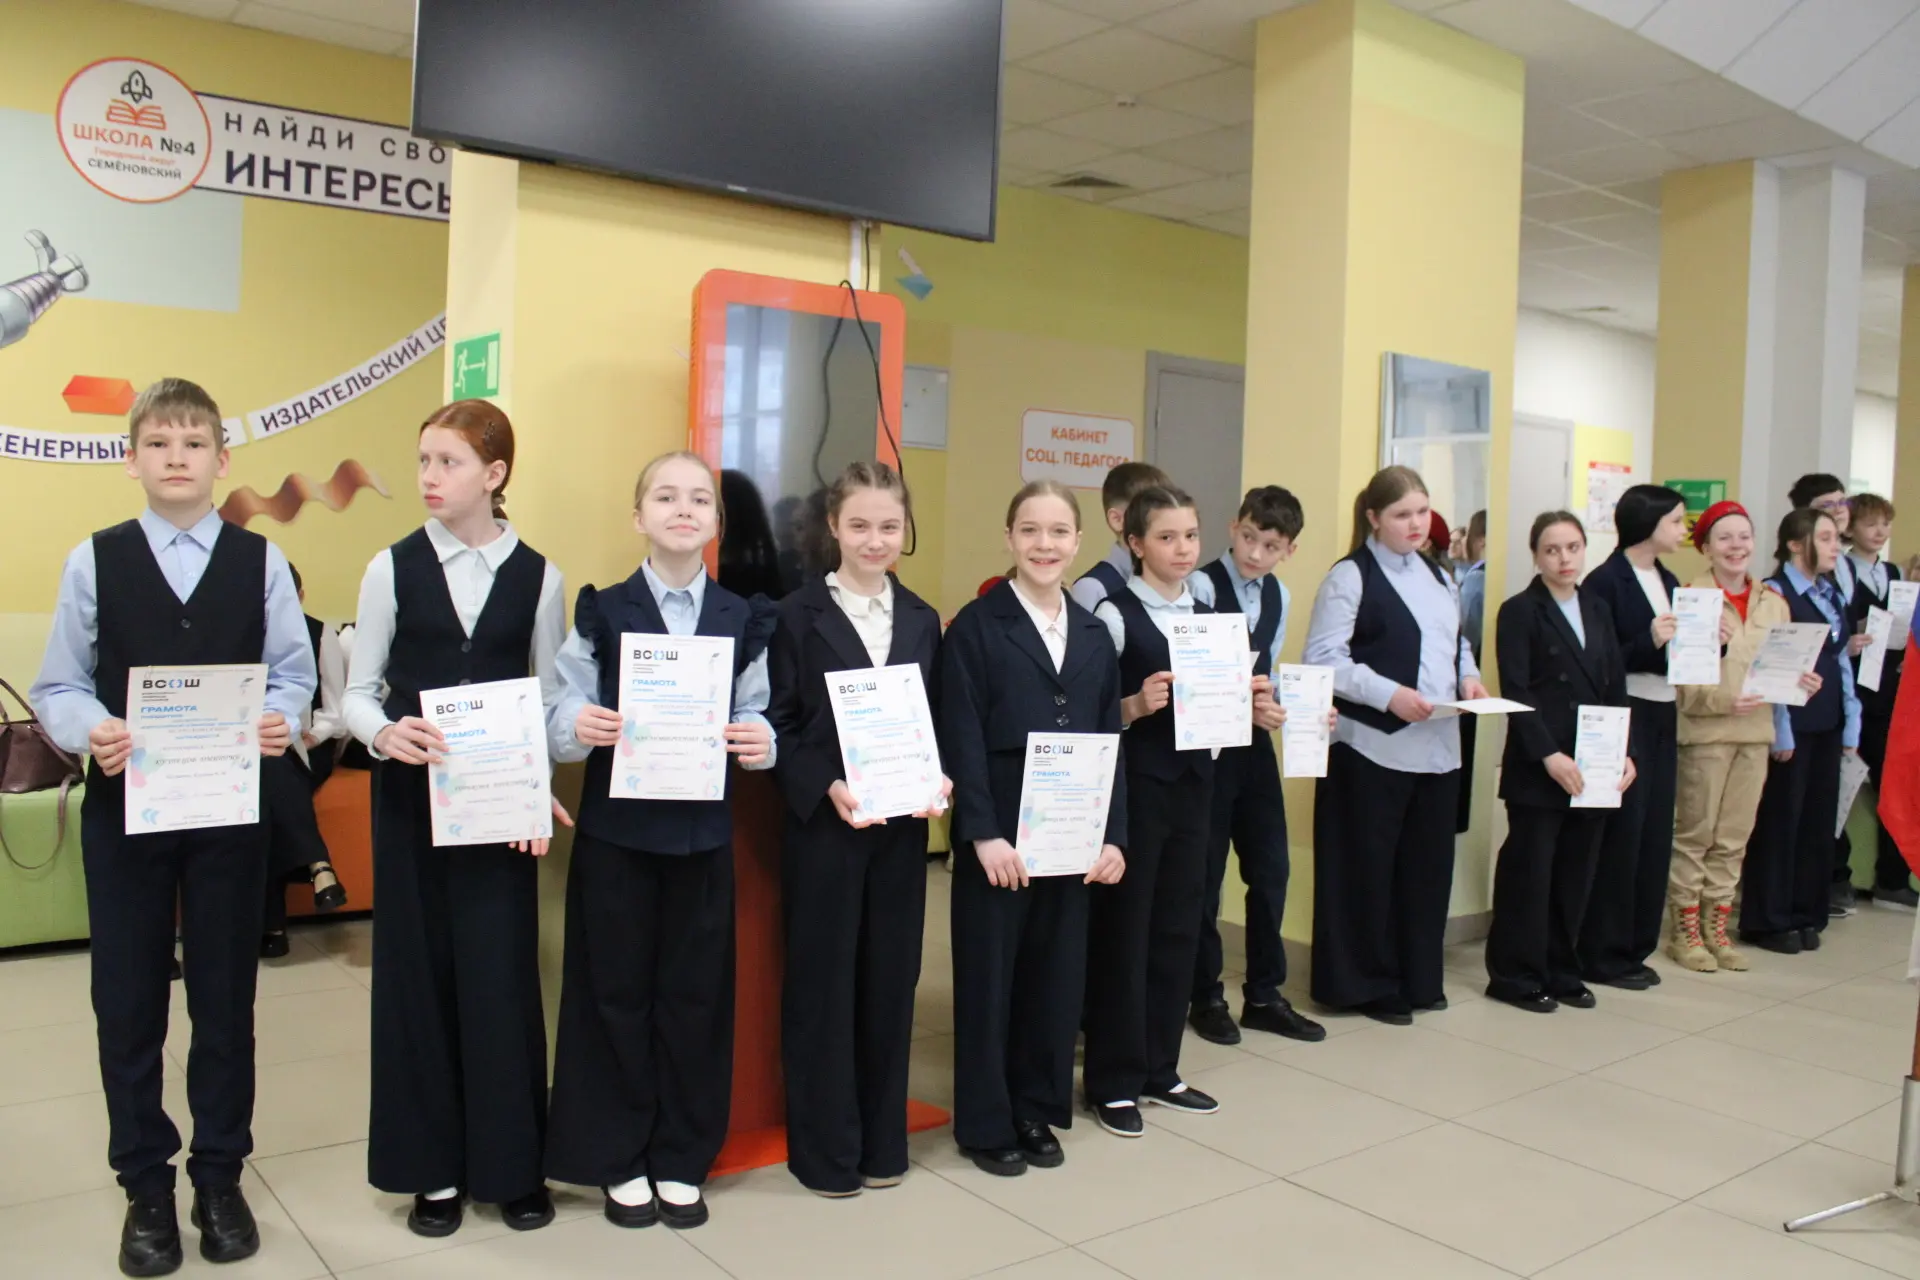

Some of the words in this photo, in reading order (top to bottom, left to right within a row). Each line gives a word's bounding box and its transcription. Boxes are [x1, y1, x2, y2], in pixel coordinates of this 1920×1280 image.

[72, 123, 153, 150] ШКОЛА
[160, 136, 196, 156] №4
[225, 111, 354, 150] НАЙДИ
[88, 157, 182, 180] СЕМЁНОВСКИЙ
[260, 335, 426, 432] ИЗДАТЕЛЬСКИЙ
[1051, 427, 1109, 444] КАБИНЕТ
[1026, 447, 1059, 466] СОЦ.
[632, 678, 677, 687] ГРАМОТА
[140, 705, 198, 713] ГРАМОТА
[445, 728, 487, 739] РАМОТА
